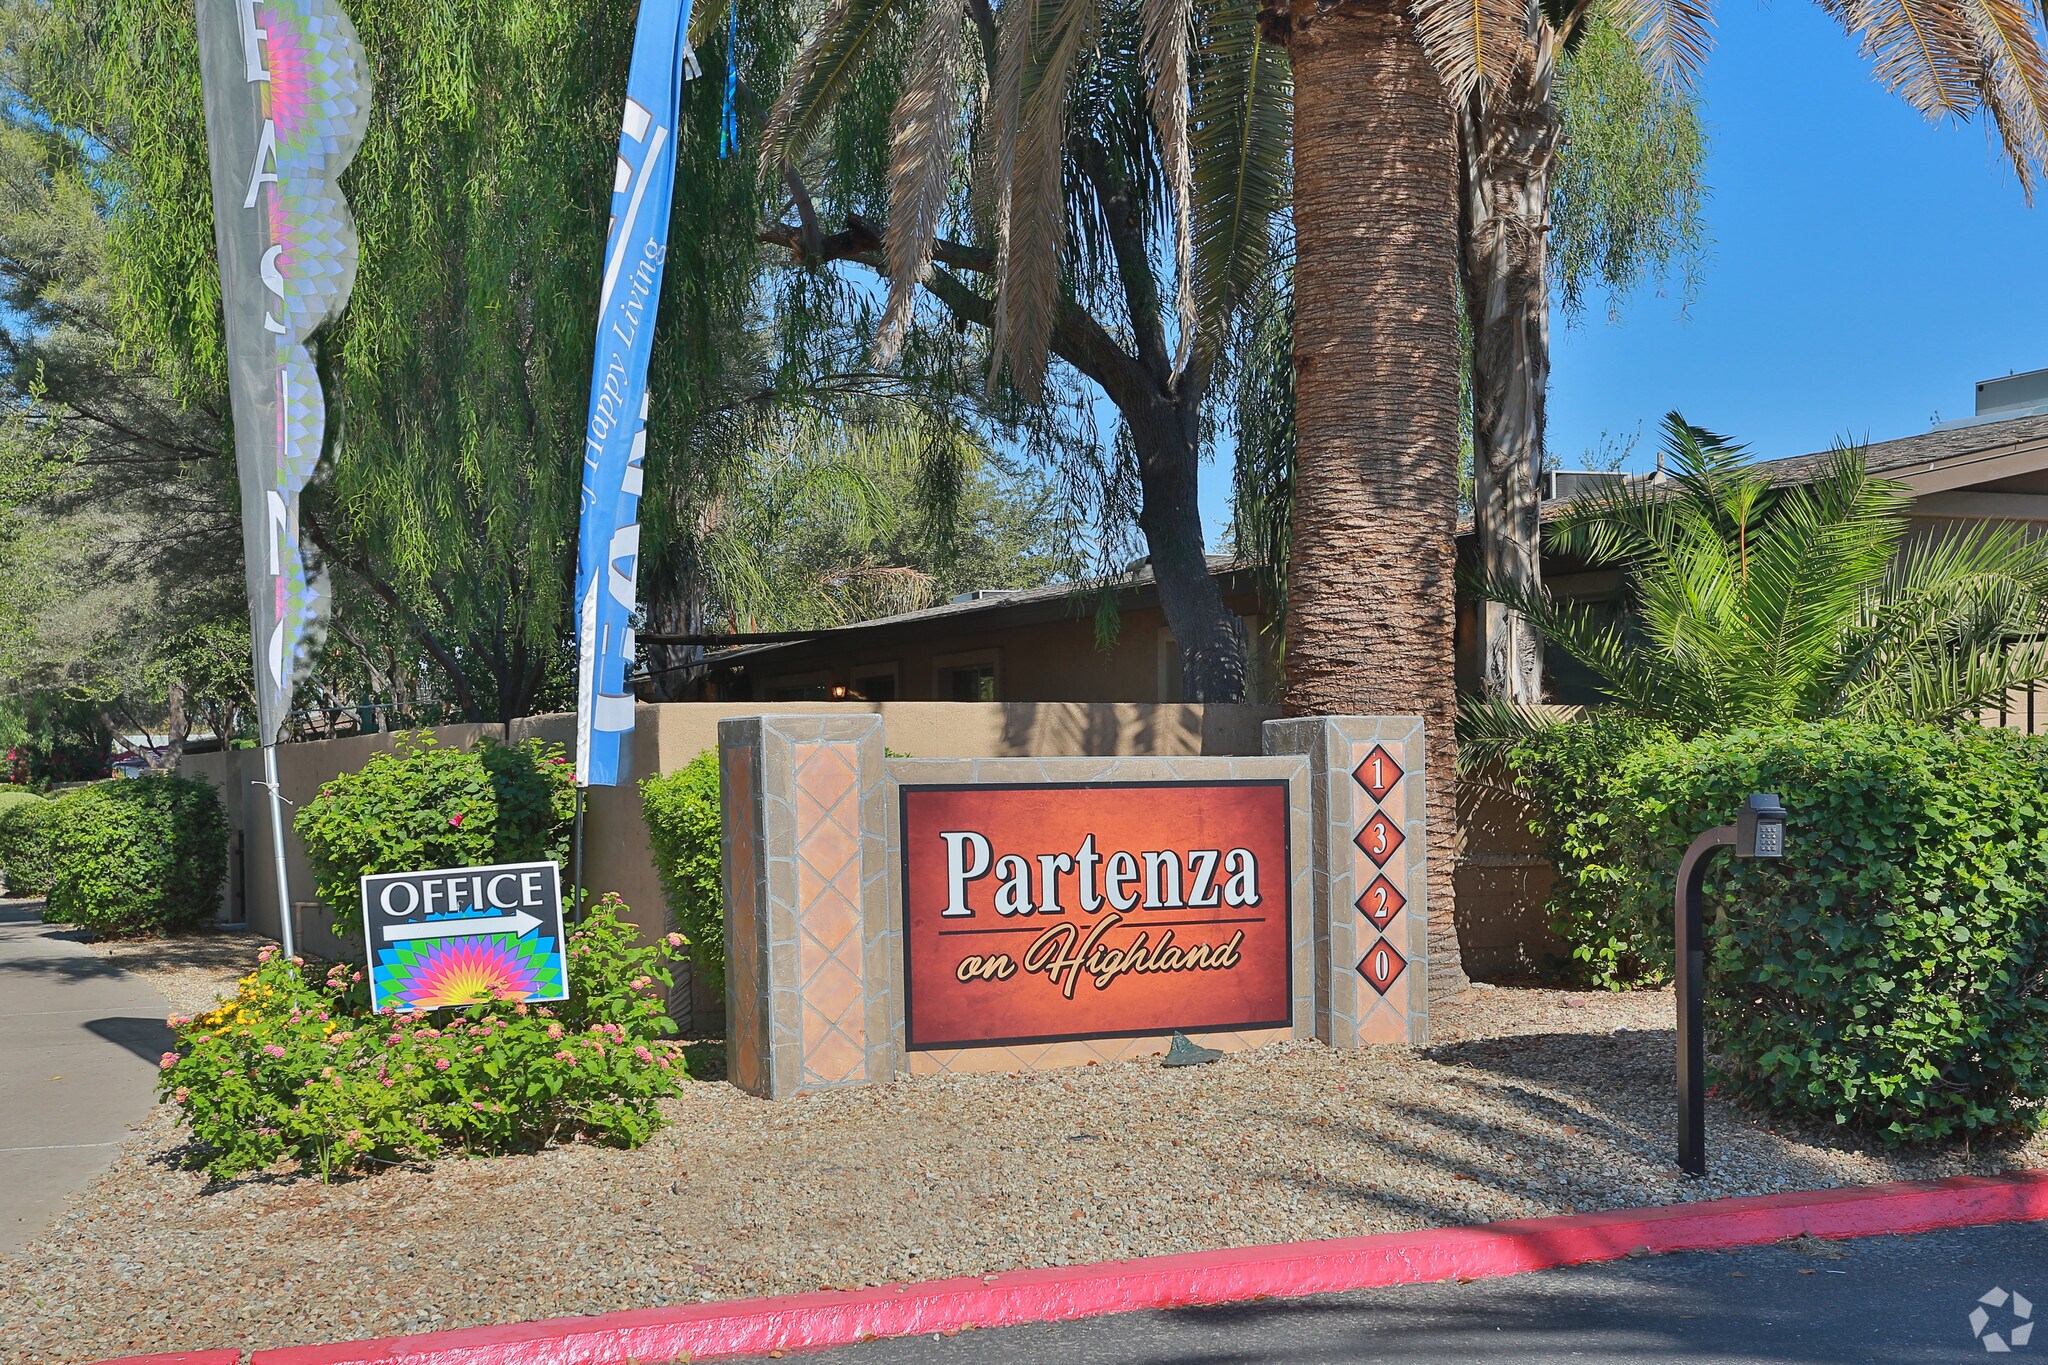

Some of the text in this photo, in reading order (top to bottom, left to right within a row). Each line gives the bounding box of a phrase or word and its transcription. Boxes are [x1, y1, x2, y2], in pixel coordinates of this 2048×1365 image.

[585, 353, 628, 473] Happy
[612, 236, 667, 350] Living
[380, 872, 543, 916] OFFICE
[939, 831, 1260, 918] Partenza
[956, 913, 1244, 999] on Highland
